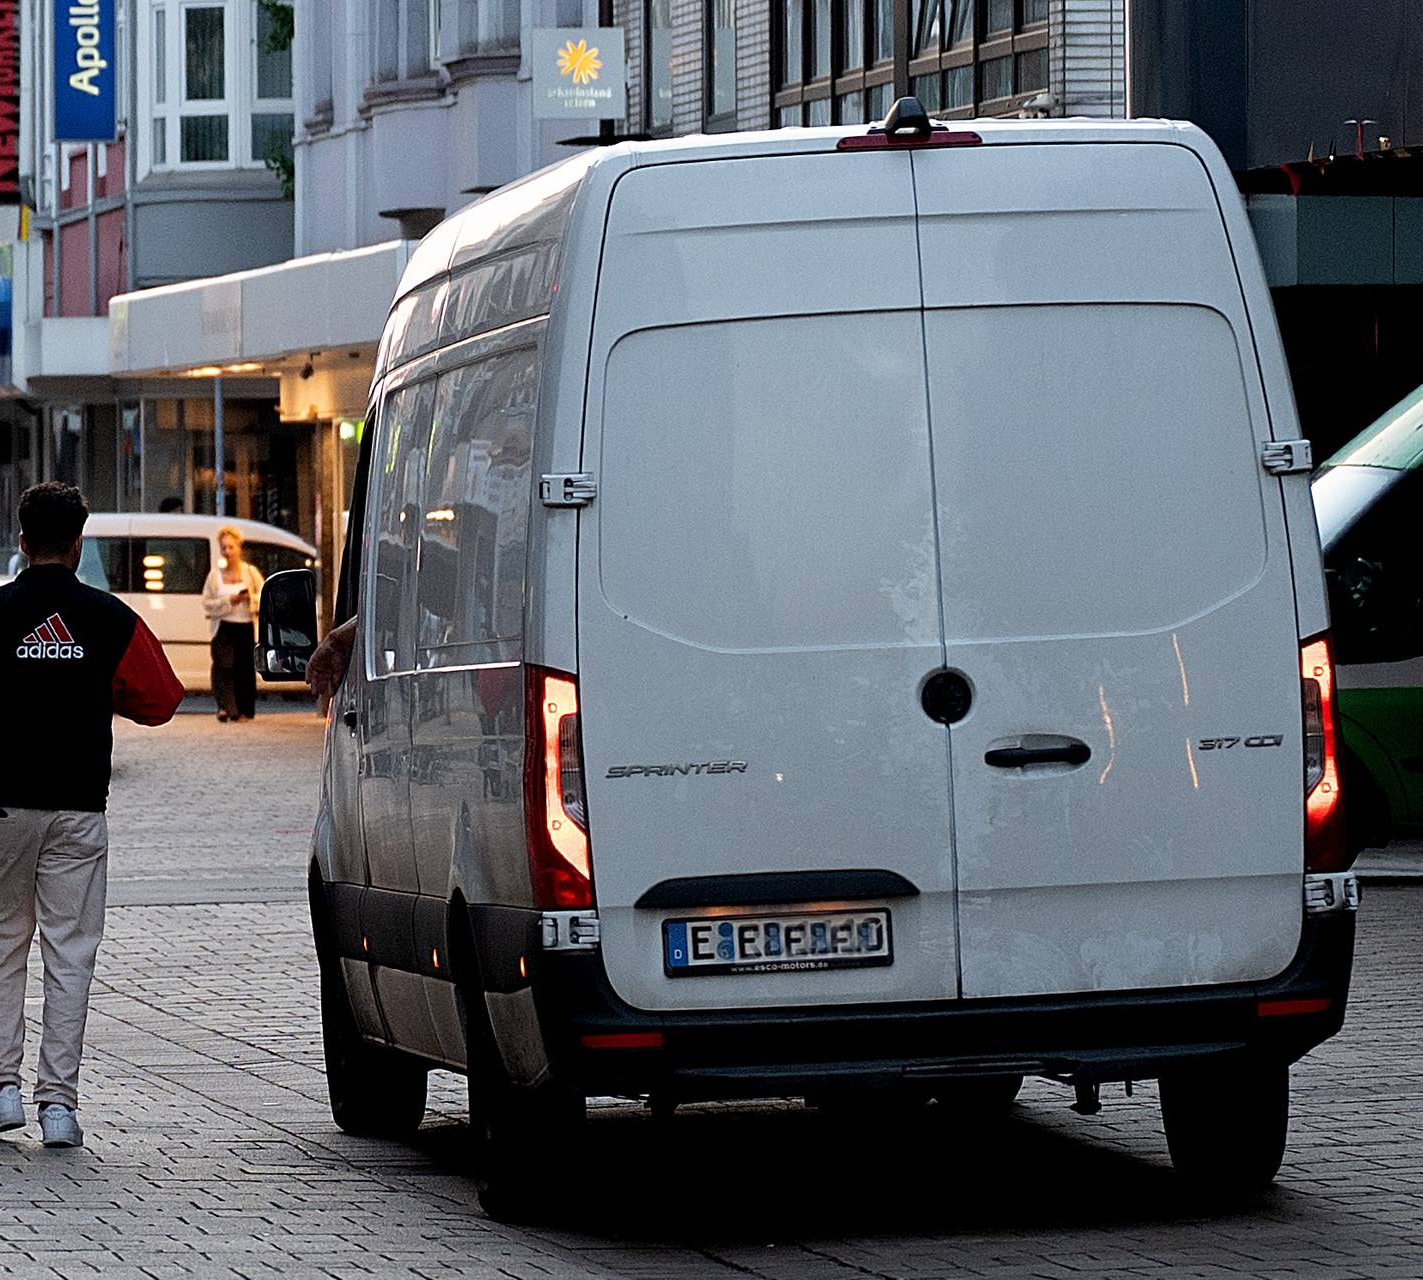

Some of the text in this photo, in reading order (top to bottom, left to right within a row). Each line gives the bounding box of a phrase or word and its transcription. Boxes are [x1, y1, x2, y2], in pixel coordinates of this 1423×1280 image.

[16, 642, 84, 659] adidas
[1198, 734, 1284, 751] 317 CDI
[605, 759, 749, 779] SPRINTER
